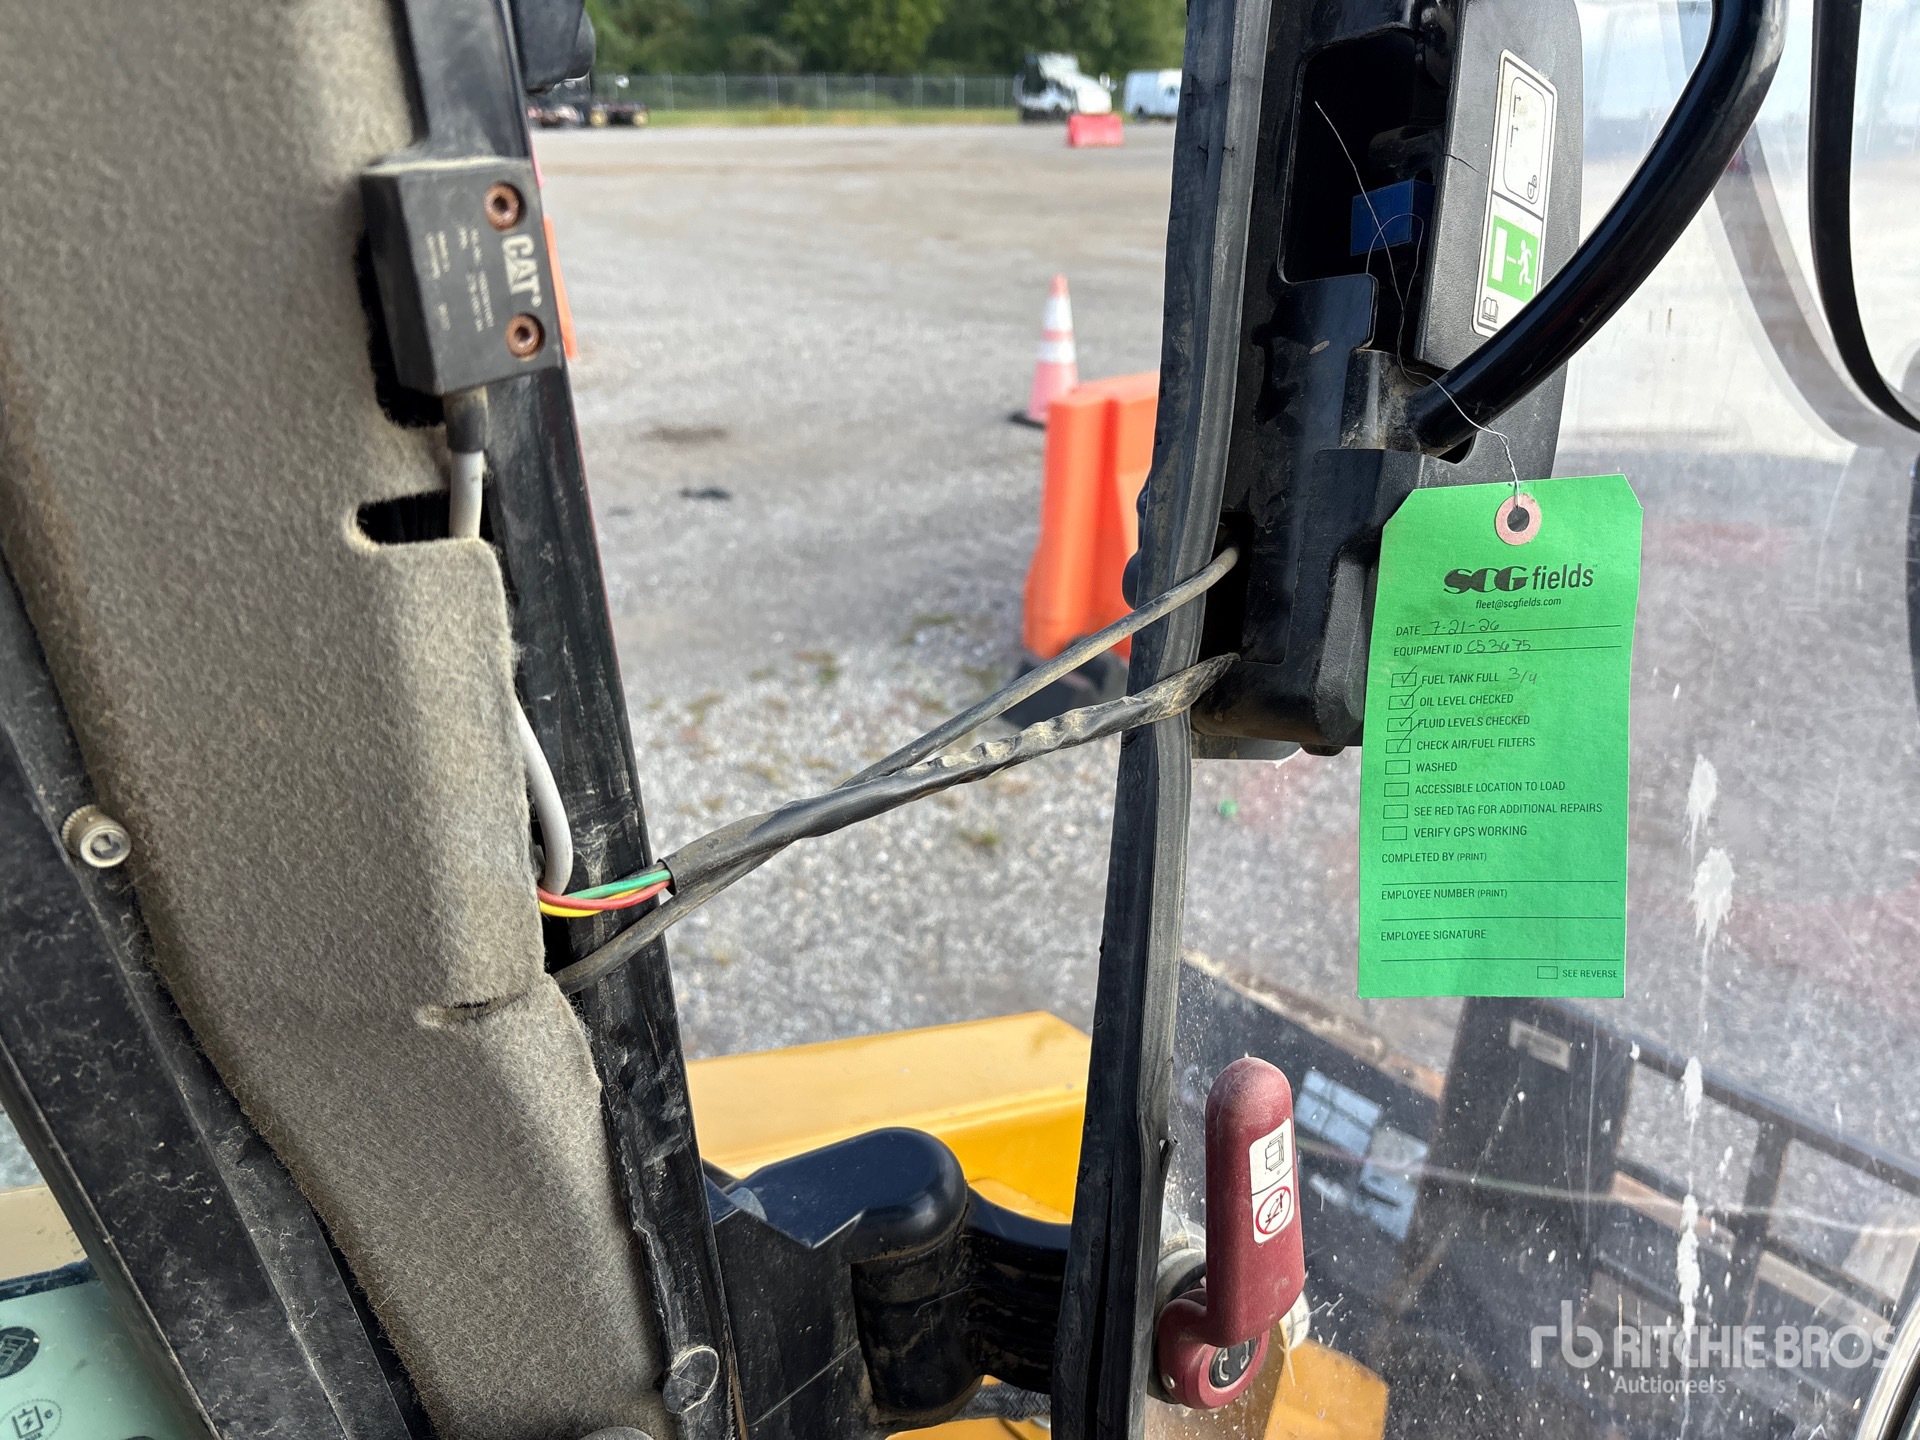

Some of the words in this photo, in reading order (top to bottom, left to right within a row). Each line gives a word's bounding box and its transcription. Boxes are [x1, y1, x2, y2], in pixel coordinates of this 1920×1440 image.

[502, 234, 540, 302] CAT
[1444, 566, 1529, 594] SCG
[1532, 563, 1594, 590] fields
[1476, 598, 1561, 610] fleet@scgfields.com
[1396, 626, 1420, 636] DATE
[1394, 645, 1449, 657] EQUIPMENT
[1453, 644, 1462, 654] ID
[1421, 674, 1445, 685] FUEL
[1449, 673, 1474, 683] TANK
[1476, 673, 1499, 682] FULL
[1420, 696, 1434, 707] OIL
[1437, 696, 1466, 706] LEVEL
[1469, 694, 1513, 704] CHECKED
[1417, 718, 1445, 728] FLUID
[1448, 717, 1483, 727] LEVELS
[1486, 715, 1530, 726] CHECKED
[1417, 740, 1448, 750] CHECK
[1451, 739, 1495, 749] AIR/FUEL
[1498, 737, 1535, 748] FILTERS
[1416, 762, 1457, 772] WASHED
[1415, 783, 1473, 795] ACCESSIBLE
[1476, 782, 1522, 792] LOCATION
[1525, 781, 1538, 791] TO
[1540, 781, 1565, 791] LOAD
[1414, 806, 1432, 816] SEE
[1434, 806, 1453, 816] RED
[1457, 805, 1475, 815] TAG
[1478, 805, 1497, 814] FOR
[1500, 804, 1557, 814] ADDITIONAL
[1560, 803, 1602, 813] REPAIRS
[1414, 827, 1450, 838] VERIFY
[1453, 827, 1475, 837] GPS
[1478, 825, 1527, 836] WORKING
[1382, 853, 1439, 863] COMPLETED
[1442, 852, 1454, 862] BY
[1457, 852, 1487, 862] (PRINT)
[1381, 890, 1431, 900] EMPLOYEE
[1433, 889, 1474, 899] NUMBER
[1477, 889, 1507, 899] (PRINT)
[1381, 930, 1430, 941] EMPLOYEE
[1433, 929, 1486, 940] SIGNATURE
[1562, 970, 1578, 978] SEE
[1580, 969, 1617, 978] REVERSE
